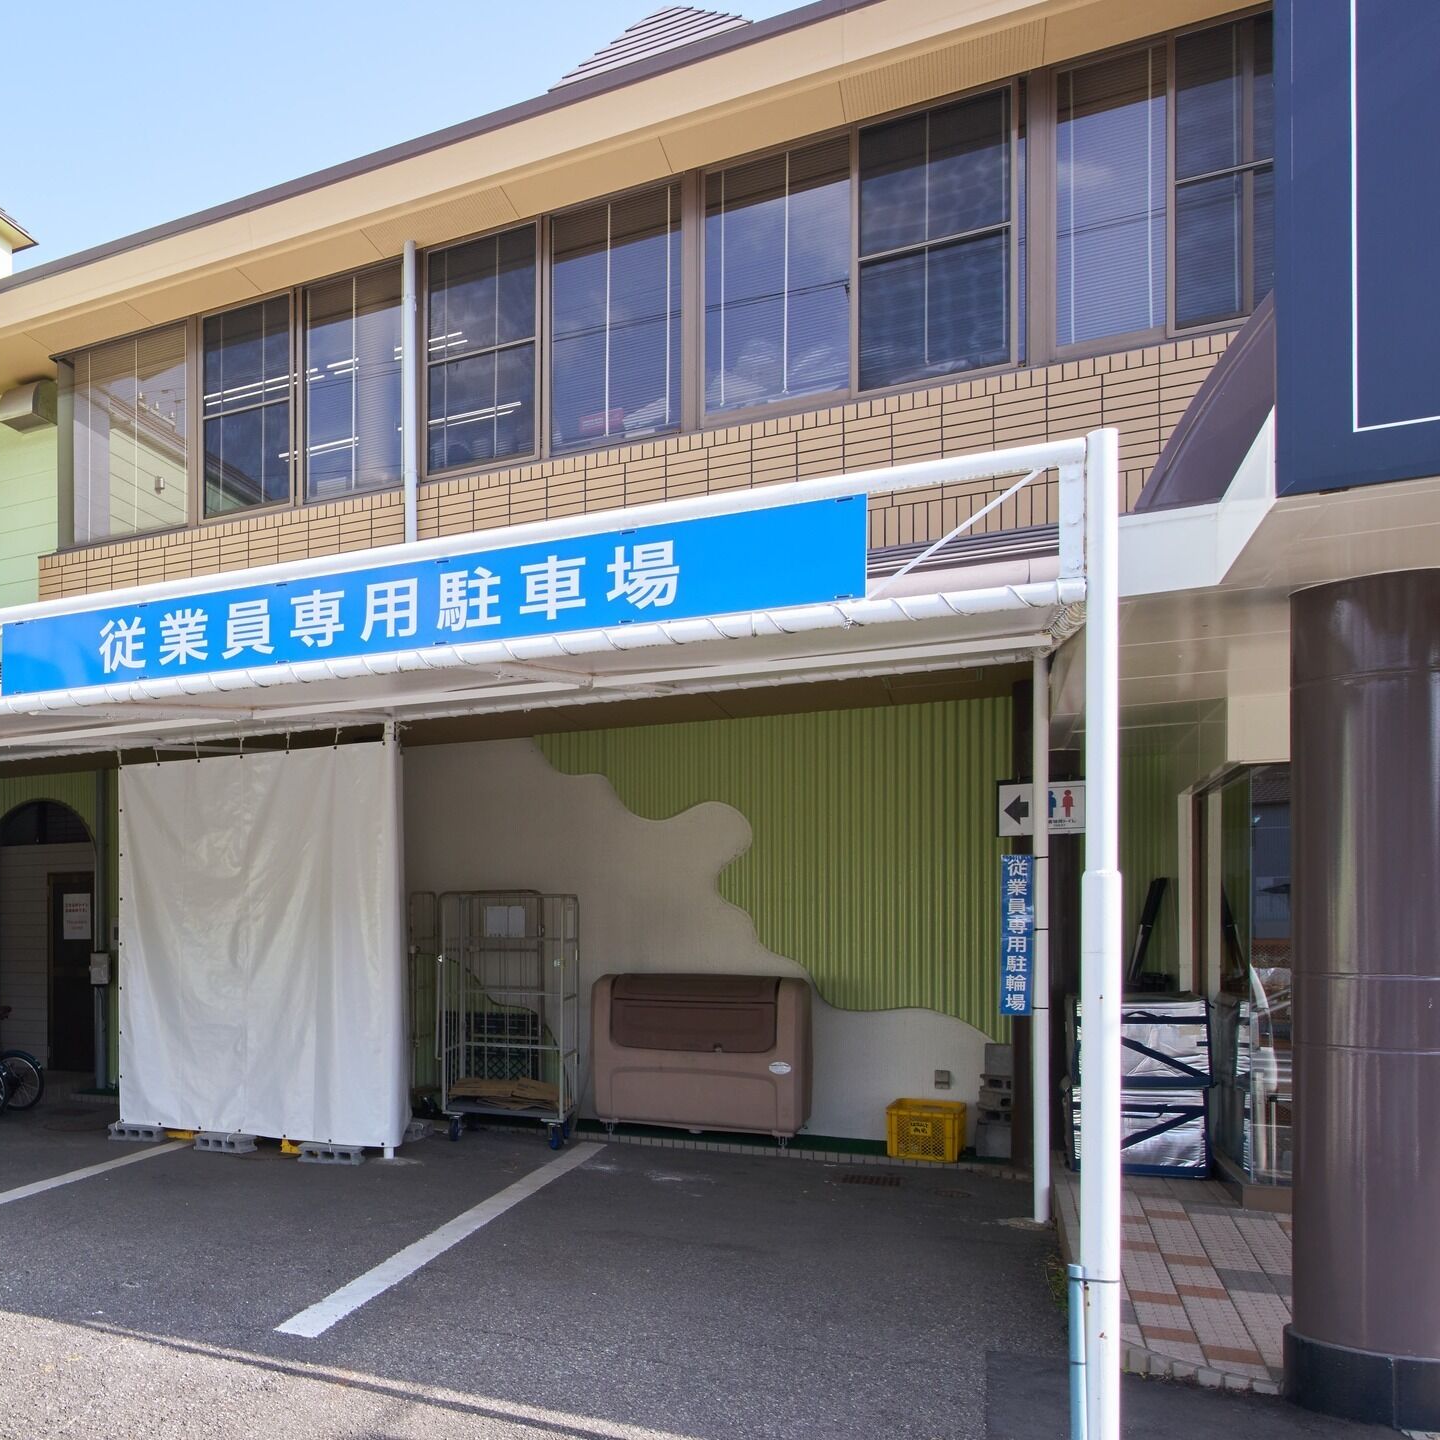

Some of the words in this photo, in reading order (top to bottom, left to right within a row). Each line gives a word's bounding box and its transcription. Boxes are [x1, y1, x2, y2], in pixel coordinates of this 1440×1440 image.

[99, 541, 680, 674] 従業員専用駐車場
[1005, 859, 1028, 1011] 従業員専用駐輪場
